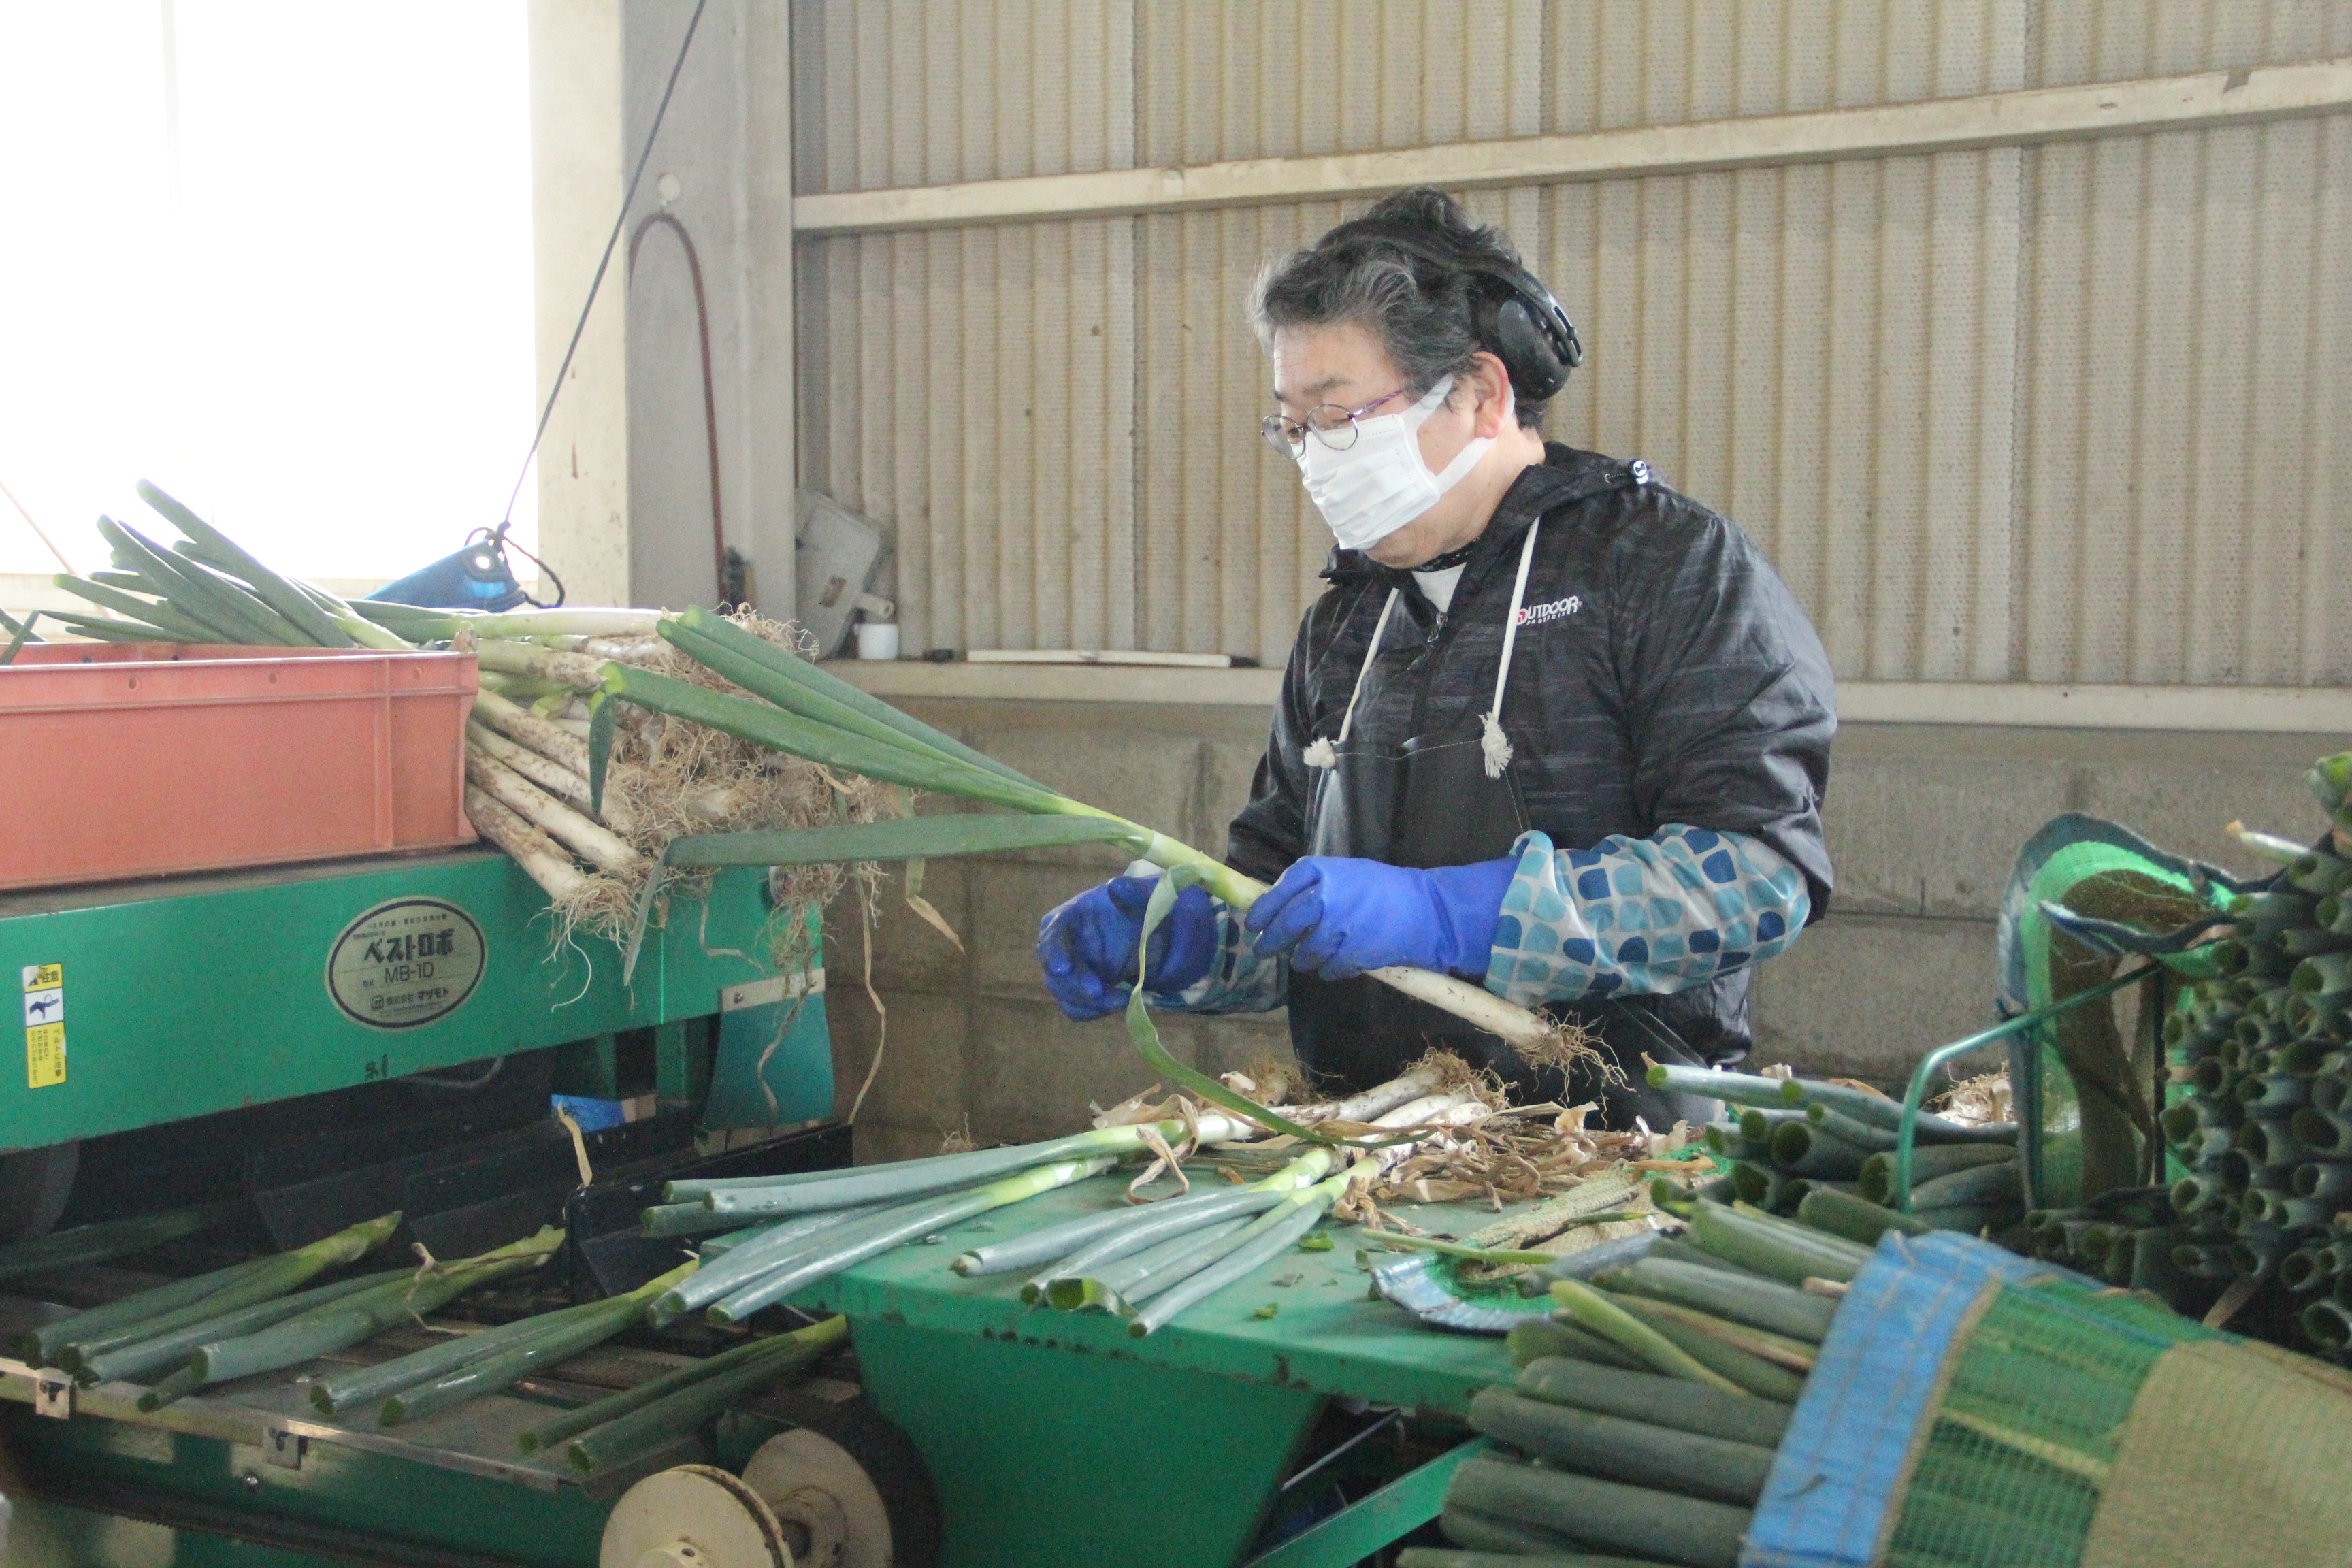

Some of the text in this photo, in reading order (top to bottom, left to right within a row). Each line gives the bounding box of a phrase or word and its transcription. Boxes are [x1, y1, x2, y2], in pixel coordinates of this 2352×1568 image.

[1516, 595, 1579, 625] OUTDOOR
[363, 928, 455, 964] ベストロボ
[417, 987, 449, 1000] マツモト
